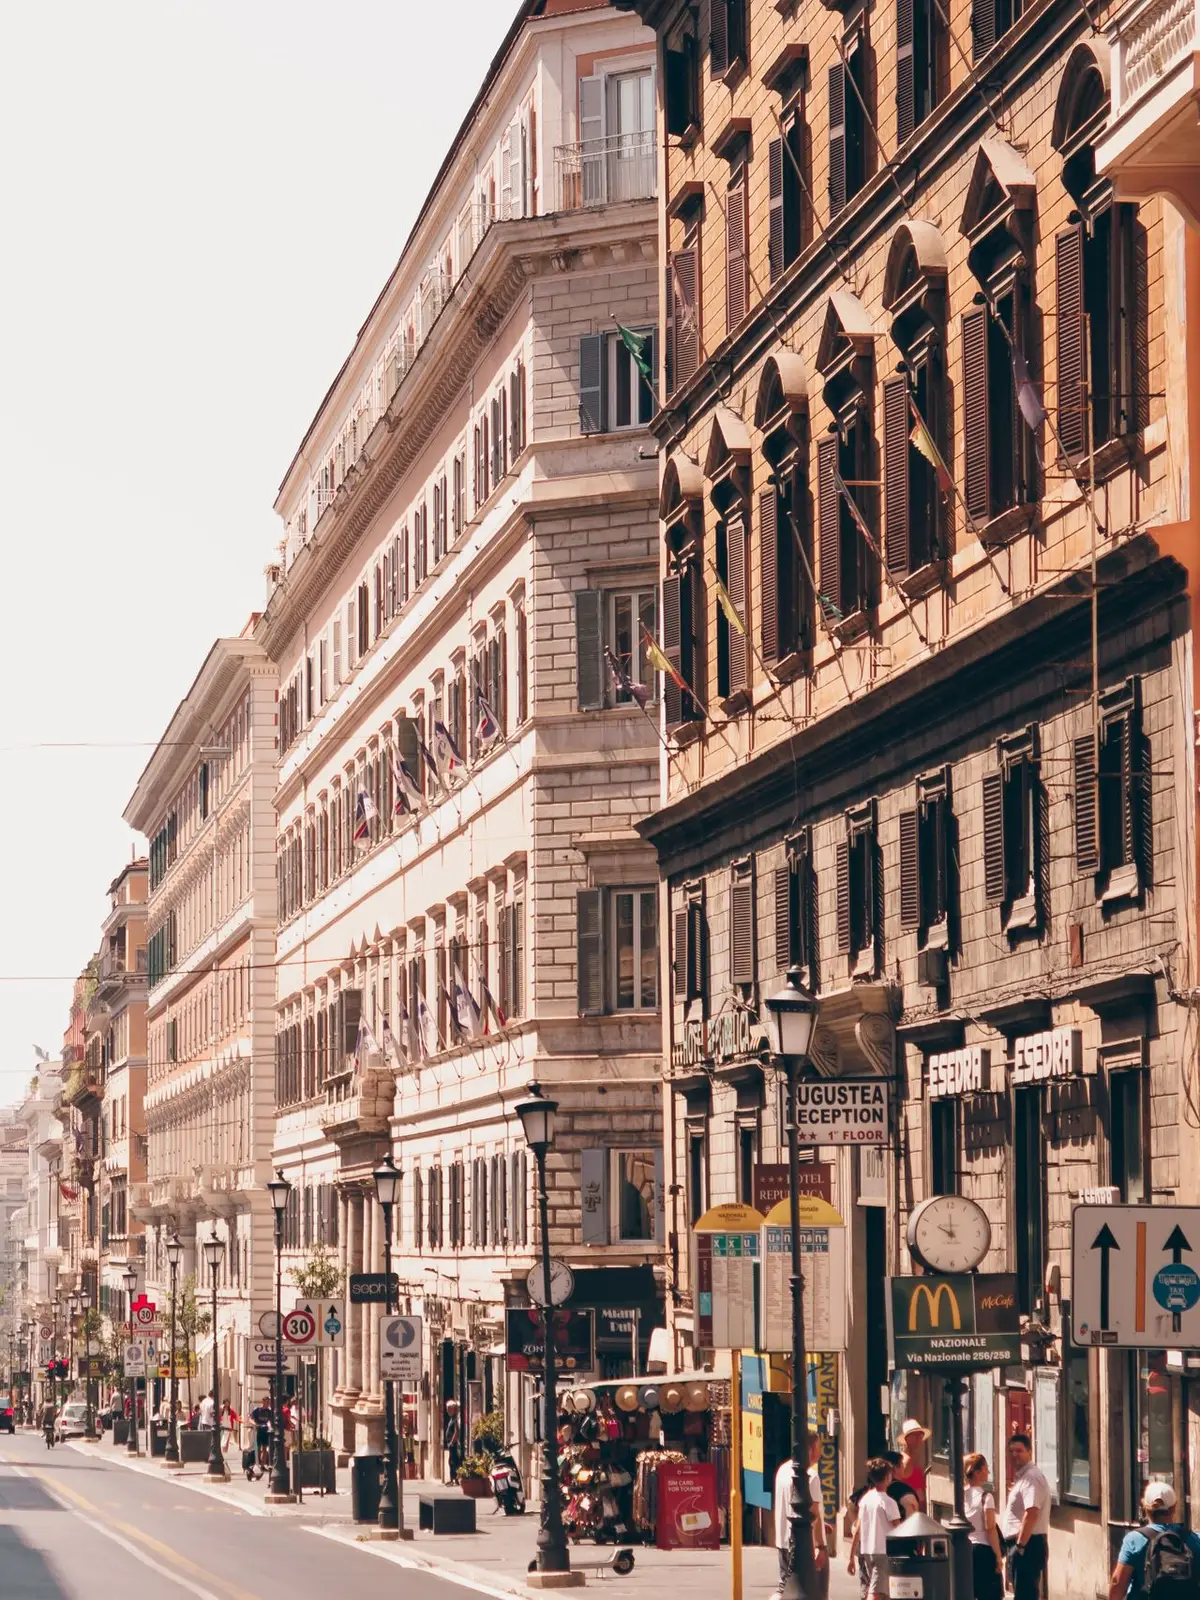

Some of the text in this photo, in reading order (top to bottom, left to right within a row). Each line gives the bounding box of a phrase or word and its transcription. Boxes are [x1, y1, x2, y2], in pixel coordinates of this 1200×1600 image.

[1014, 1028, 1073, 1083] ESEDRA
[929, 1047, 982, 1097] ESEDRA
[786, 1085, 884, 1106] UGUSTEA
[786, 1107, 884, 1125] ECEPTION
[843, 1131, 883, 1140] FLOOR
[140, 1309, 151, 1320] 30
[290, 1319, 309, 1335] 30
[930, 1338, 987, 1348] NAZIONALE
[160, 1353, 170, 1365] P
[907, 1351, 1011, 1362] Via Nazionale 256/258
[820, 1353, 835, 1421] CHANG
[820, 1433, 835, 1519] CHANGE
